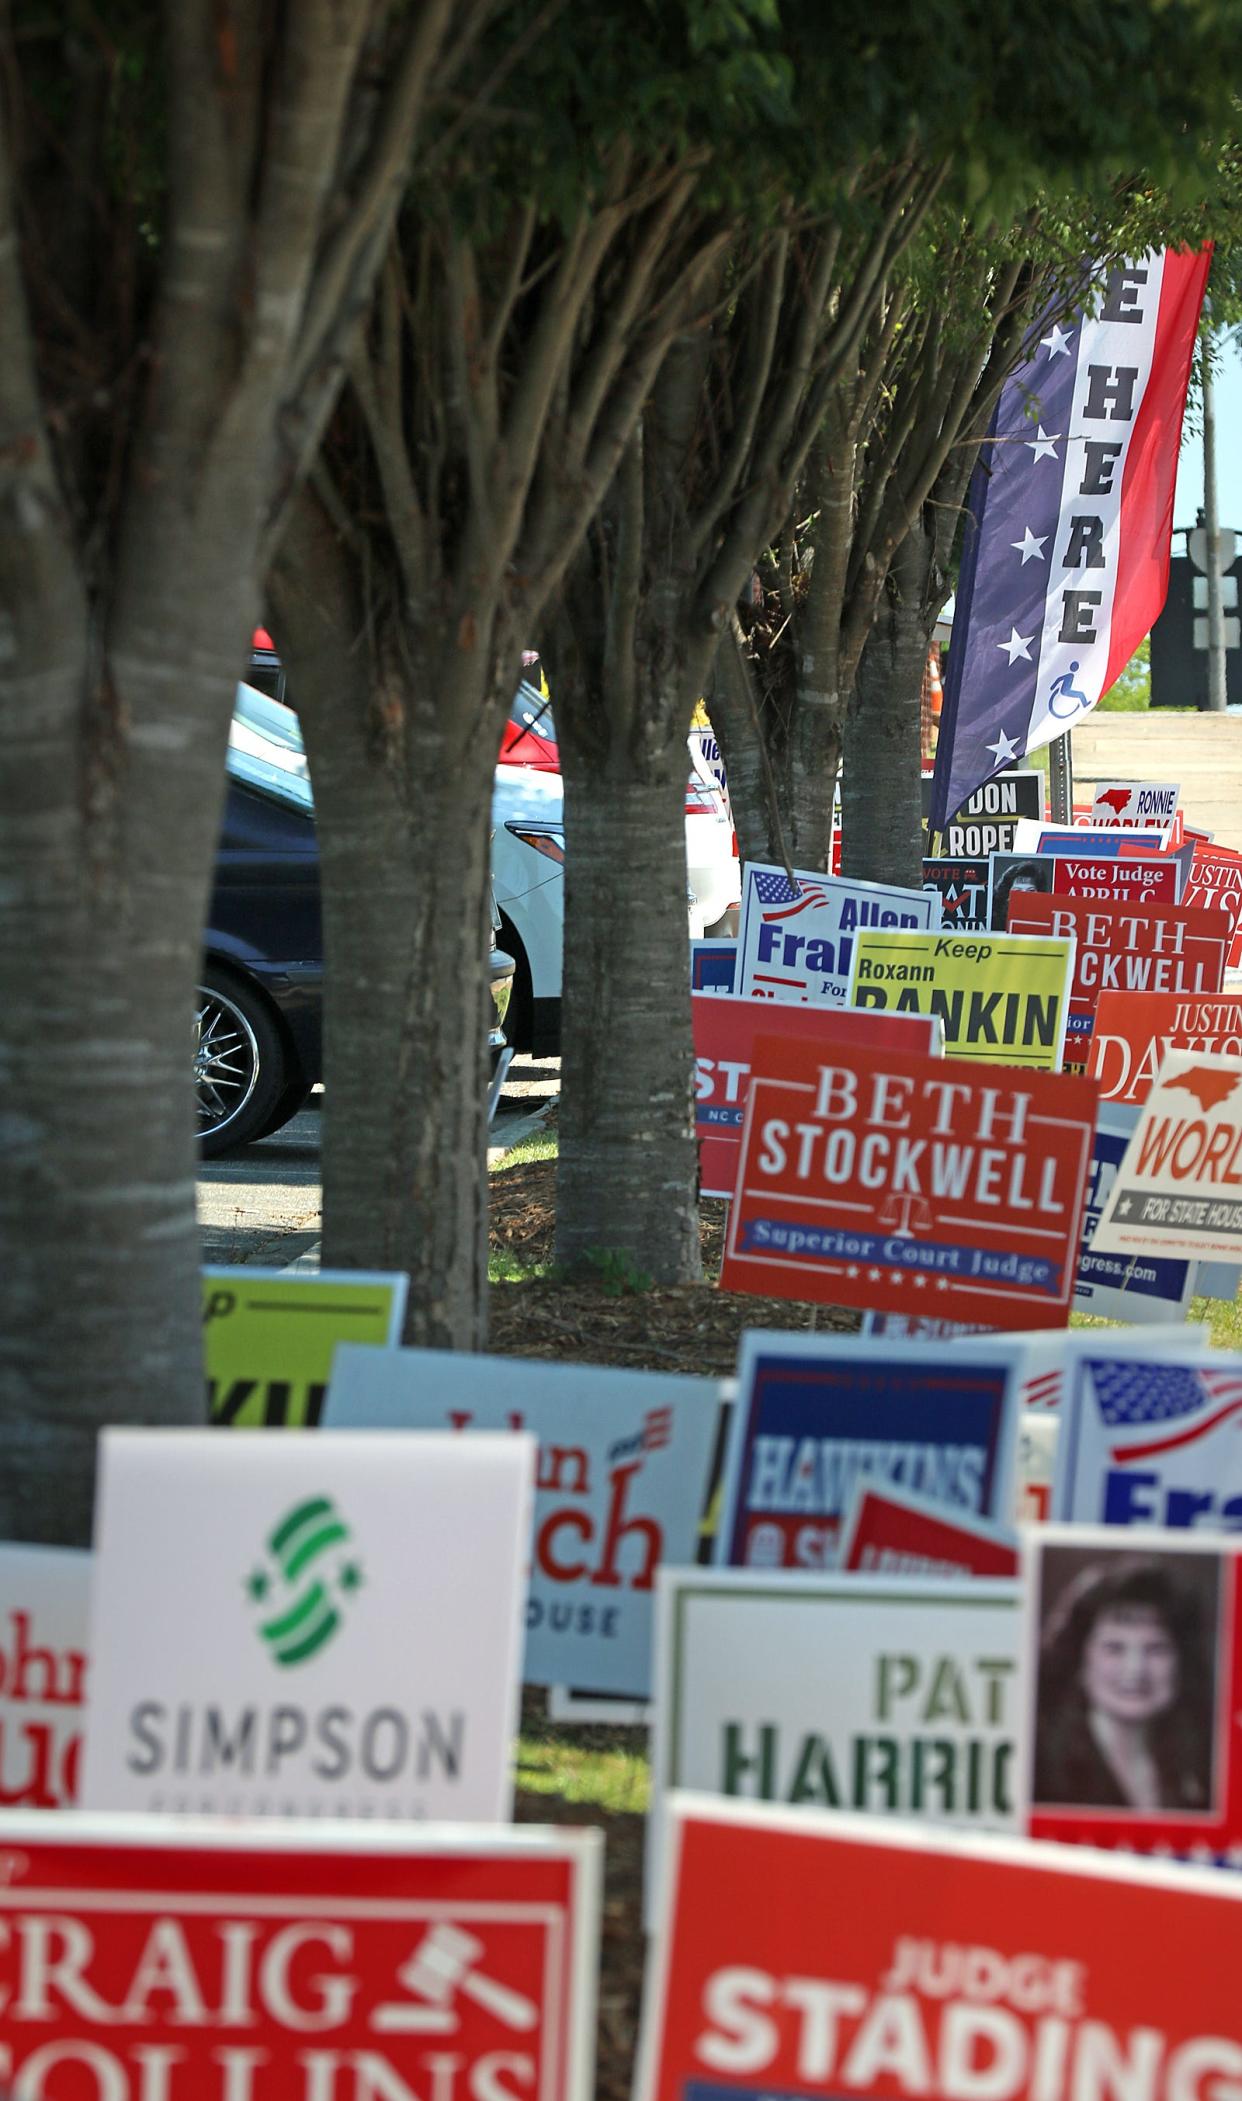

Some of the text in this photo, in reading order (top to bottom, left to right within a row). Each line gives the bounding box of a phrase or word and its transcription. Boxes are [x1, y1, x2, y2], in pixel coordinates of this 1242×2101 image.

[1058, 364, 1139, 644] HERE
[1137, 791, 1176, 814] RONNIE
[949, 825, 1018, 857] ROPE
[1065, 864, 1164, 887] Vote Judge
[1189, 862, 1242, 889] USTIN
[842, 897, 920, 933] Allen
[1048, 910, 1187, 955] BETH
[858, 958, 935, 982] Roxann
[934, 939, 993, 963] Keep
[810, 1065, 1033, 1145] BETH
[759, 1118, 1065, 1213] STOCKWELL
[1142, 1197, 1171, 1222] FOR
[1169, 1199, 1211, 1225] STATE
[753, 1219, 1050, 1285] Superior Court Judge
[874, 1651, 1015, 1726] PAT
[128, 1699, 466, 1785] SIMPSON
[0, 1913, 358, 2033] RAIG
[884, 1936, 1086, 2019] JUDGE
